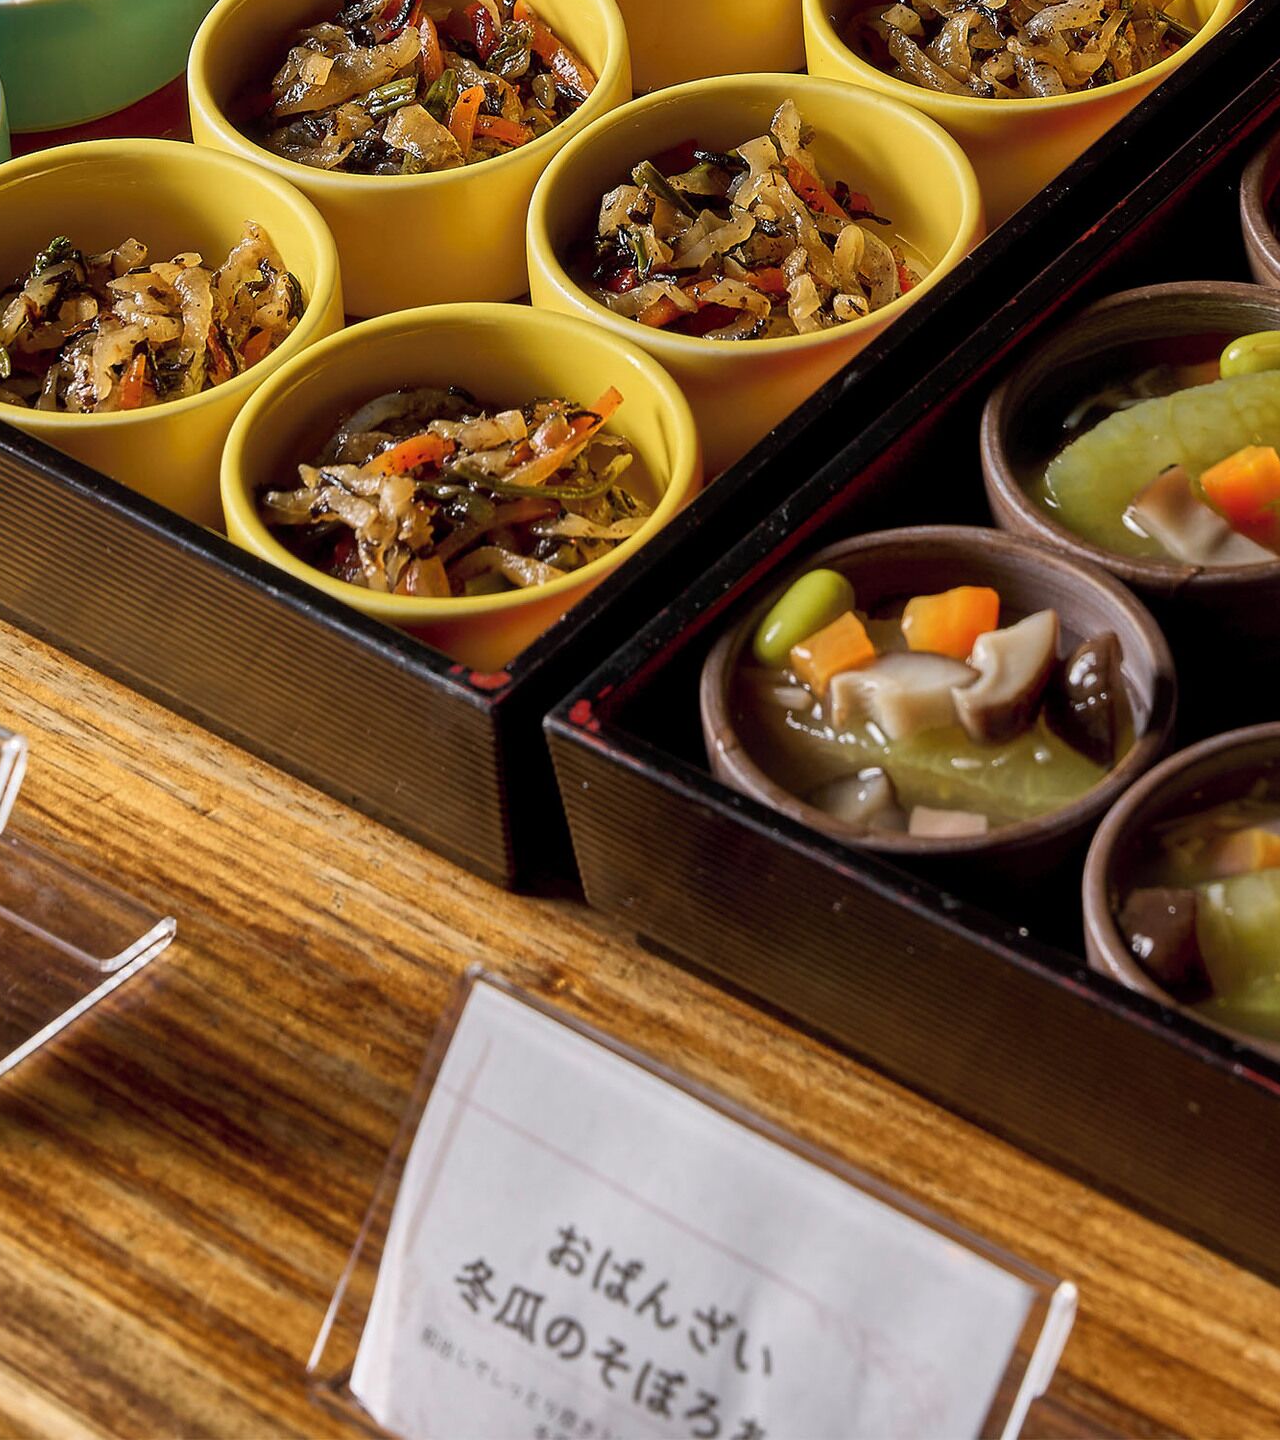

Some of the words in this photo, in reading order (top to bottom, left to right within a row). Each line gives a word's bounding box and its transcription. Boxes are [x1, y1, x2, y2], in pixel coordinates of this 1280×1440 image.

[546, 1226, 773, 1377] おばんざい
